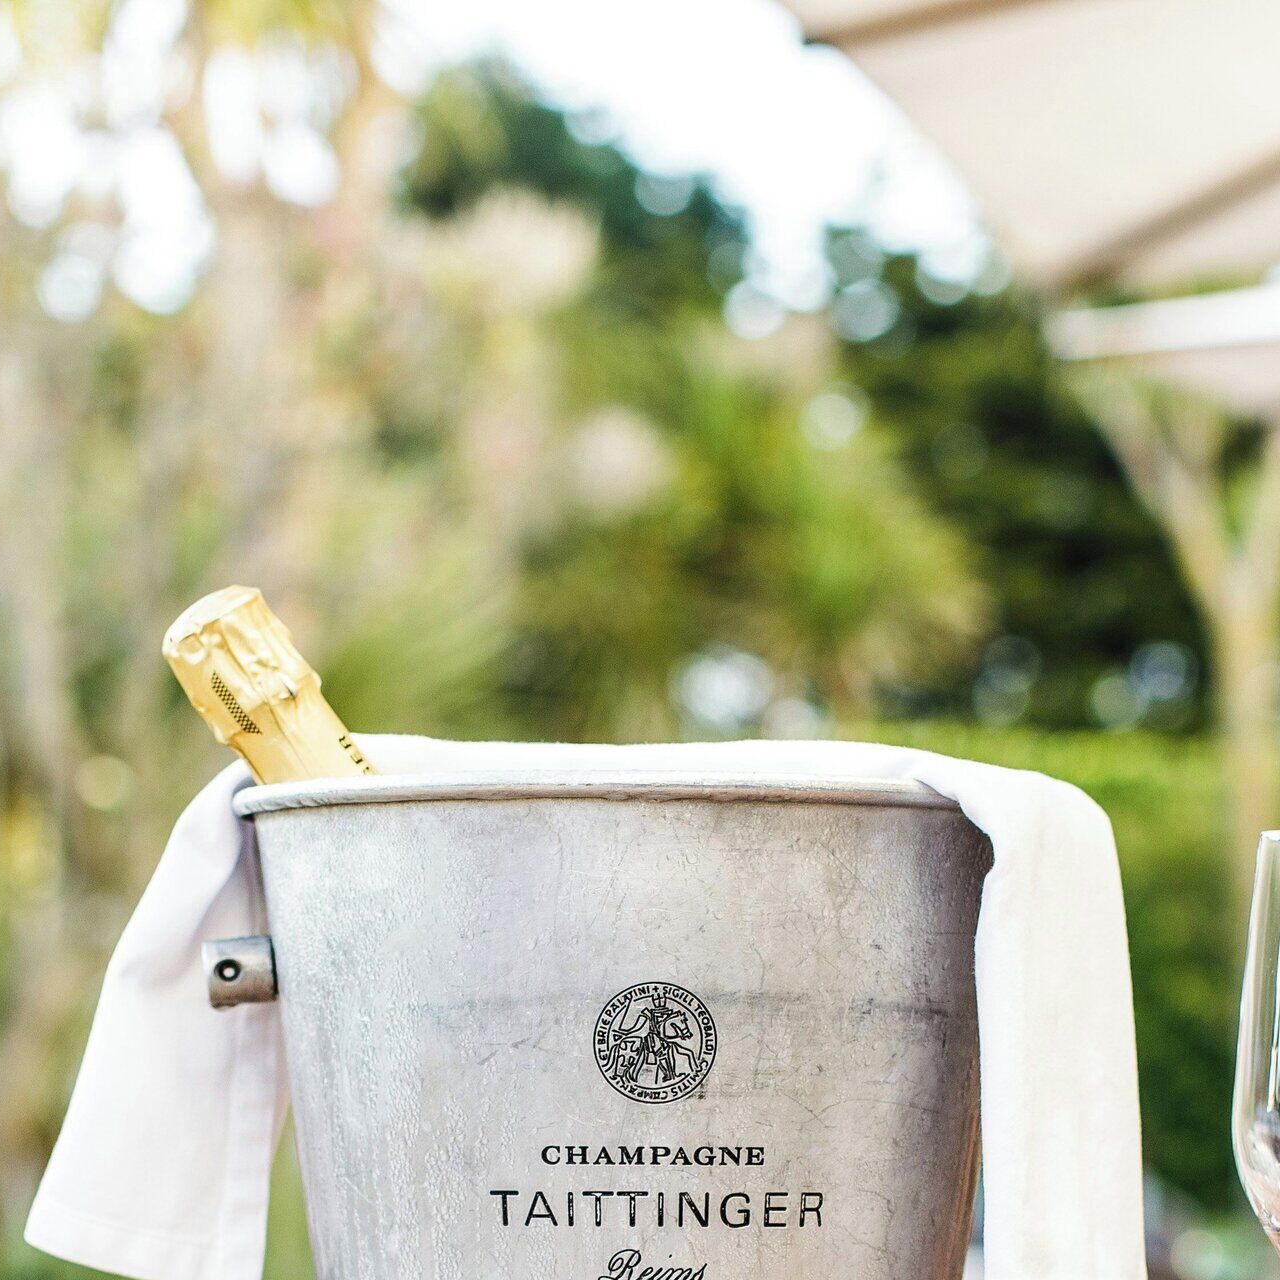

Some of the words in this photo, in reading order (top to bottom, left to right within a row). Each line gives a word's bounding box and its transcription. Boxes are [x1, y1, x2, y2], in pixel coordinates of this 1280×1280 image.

[663, 986, 696, 1006] SIGILL
[598, 1018, 610, 1043] BRIE
[694, 1004, 714, 1055] TEOBALDI
[541, 1145, 765, 1166] CHAMPAGNE
[490, 1190, 824, 1228] TAITTINGER
